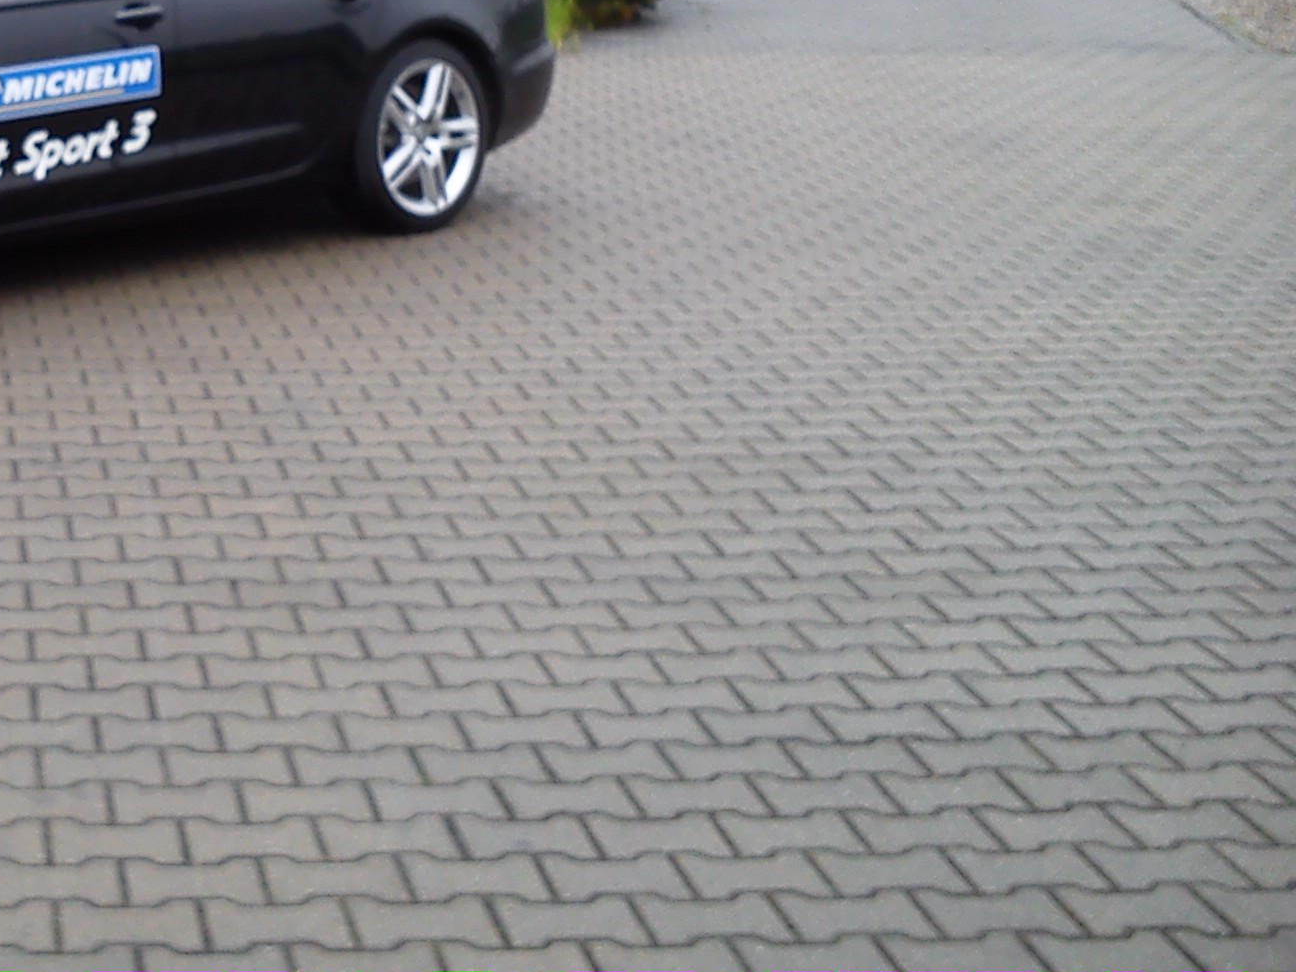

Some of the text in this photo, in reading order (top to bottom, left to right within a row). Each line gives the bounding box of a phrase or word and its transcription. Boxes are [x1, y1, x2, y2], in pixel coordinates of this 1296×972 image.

[3, 58, 153, 103] MICHELIN
[13, 119, 119, 181] Sport
[122, 108, 158, 155] 3
